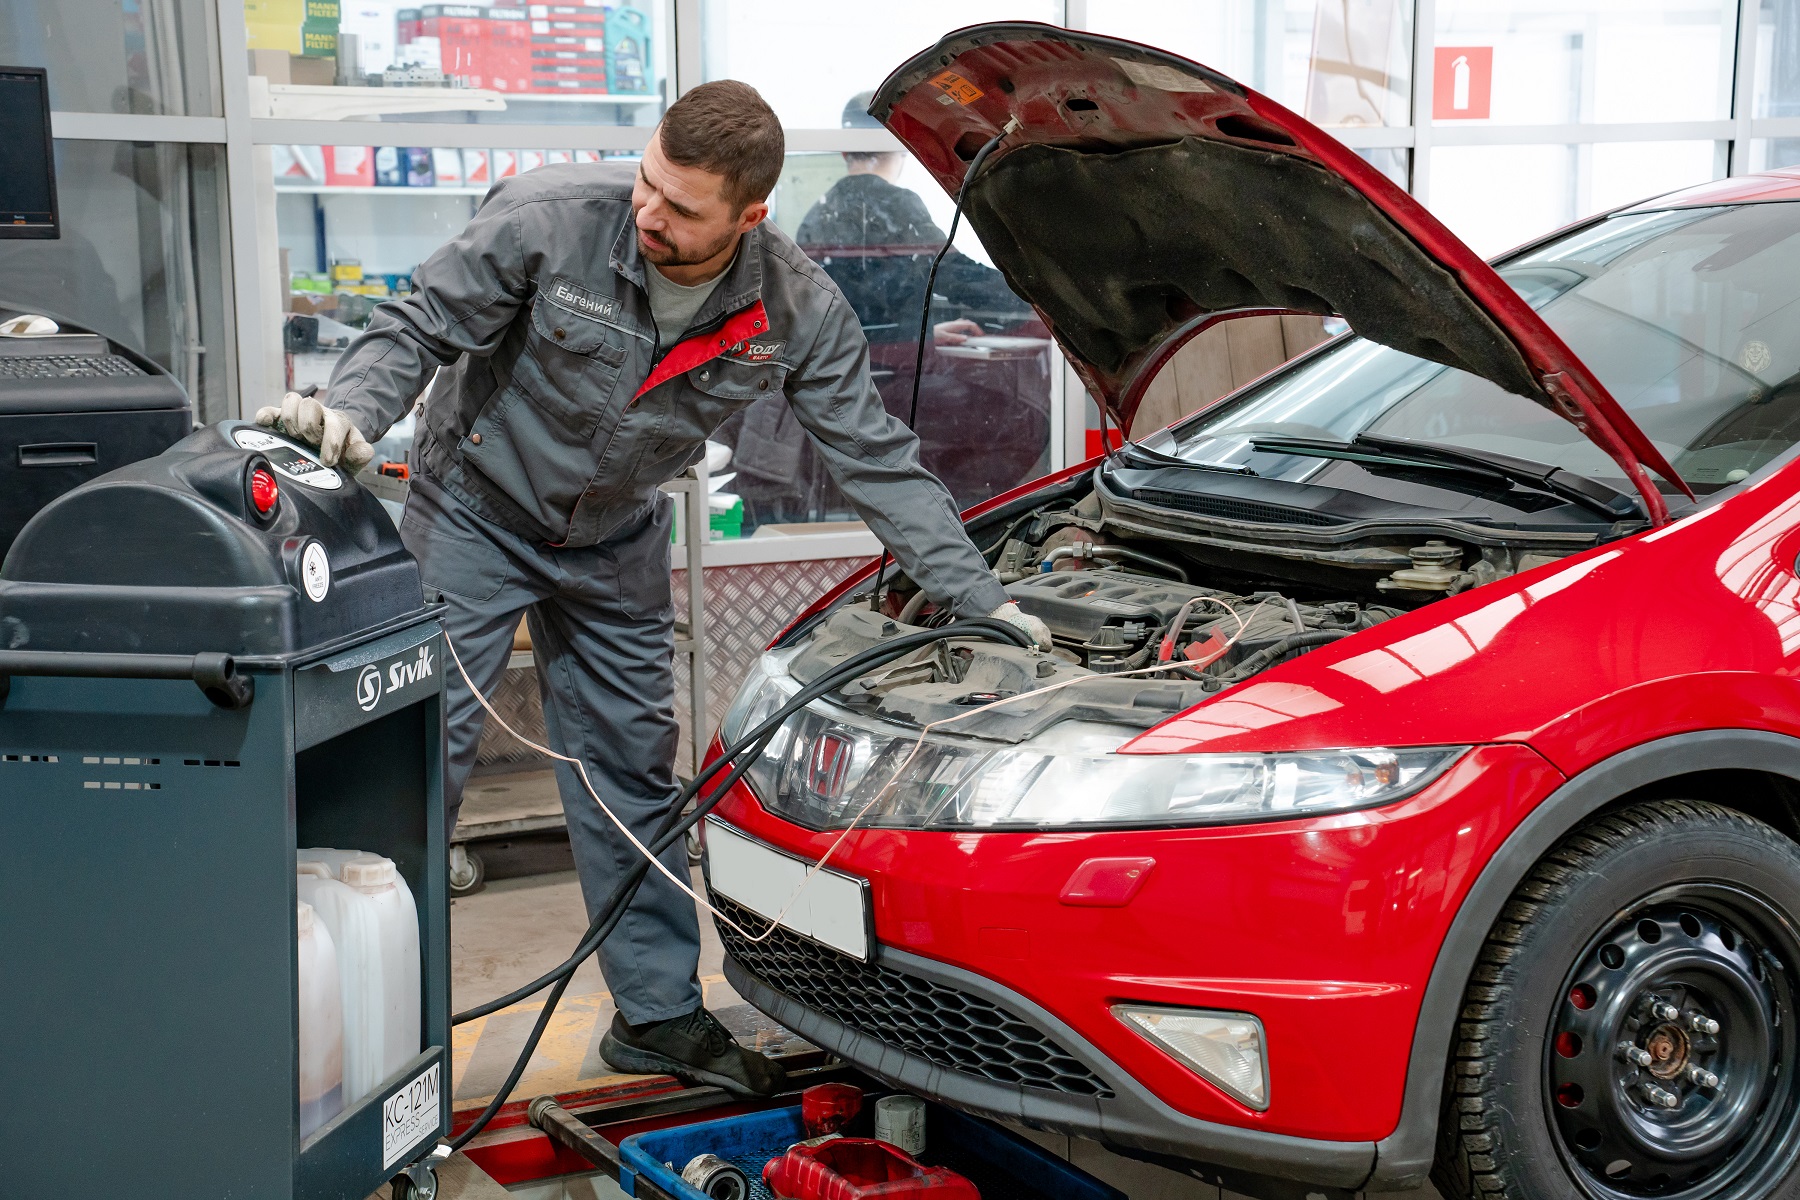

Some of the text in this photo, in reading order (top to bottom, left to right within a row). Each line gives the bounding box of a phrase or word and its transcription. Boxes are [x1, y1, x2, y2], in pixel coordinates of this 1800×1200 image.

[308, 2, 338, 10] MANN
[308, 9, 339, 18] FILTER
[305, 33, 335, 41] MANN
[305, 41, 336, 49] FILTER
[556, 285, 612, 316] Евгений
[418, 1114, 439, 1138] SERVICE
[385, 1112, 421, 1152] EXPRESS
